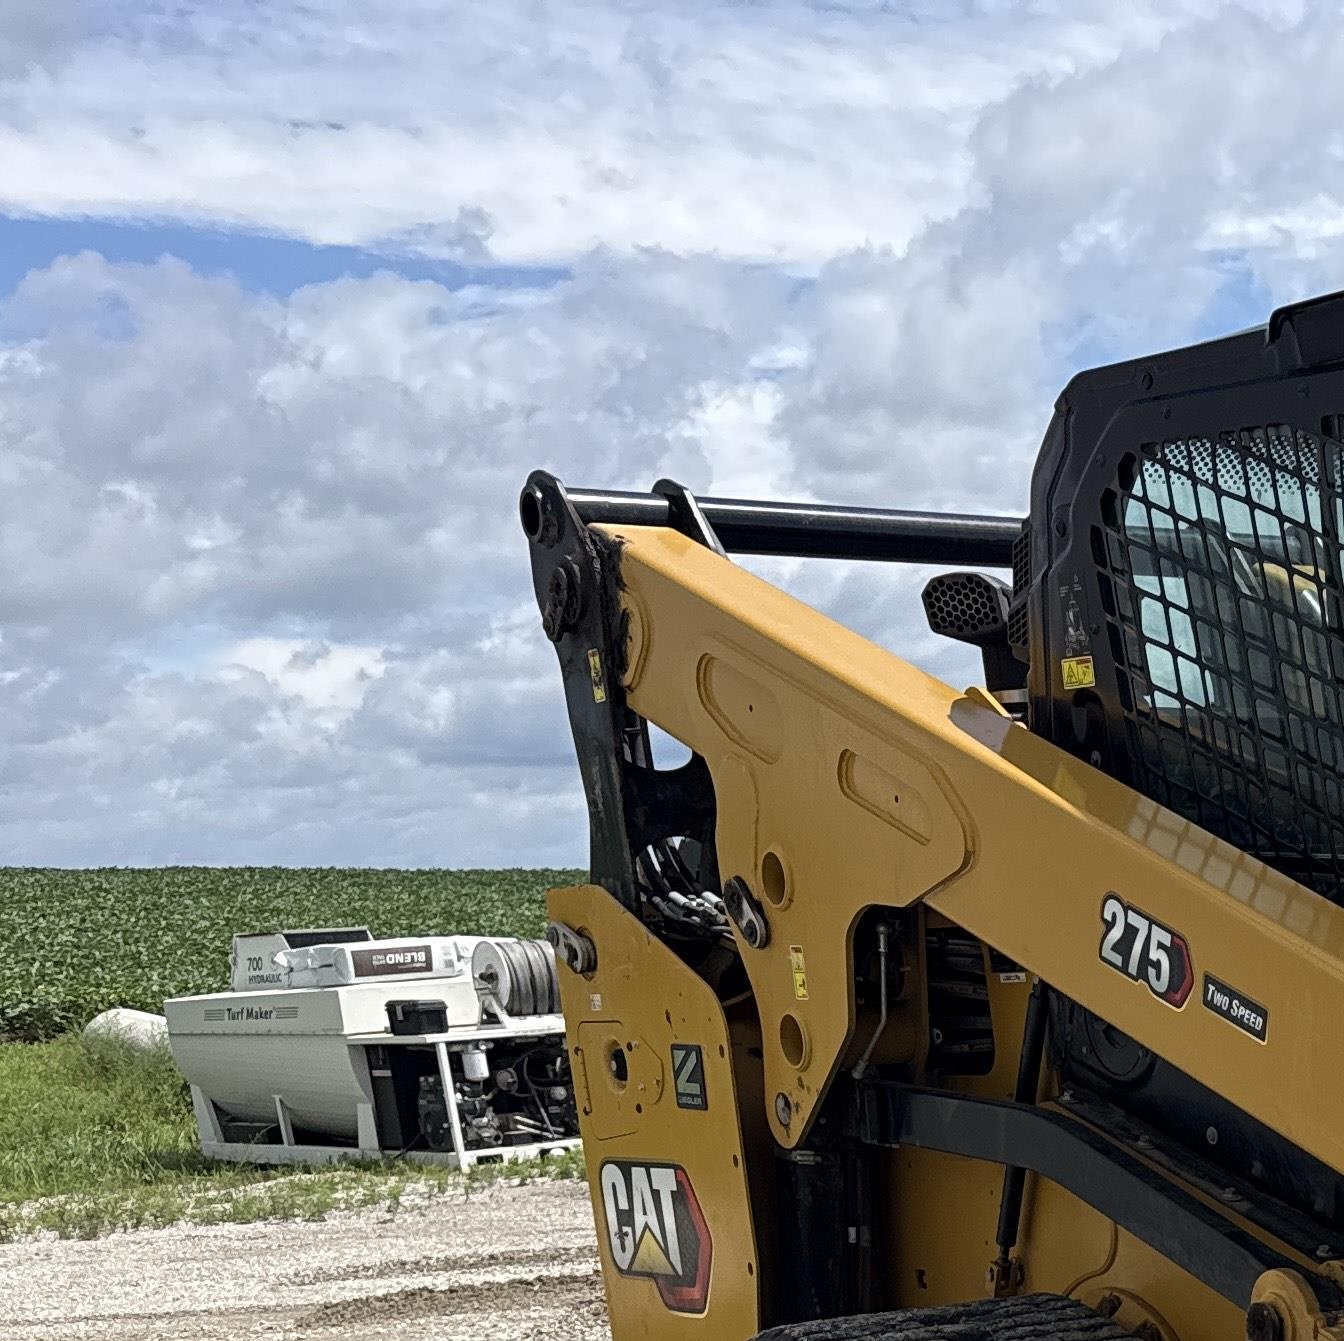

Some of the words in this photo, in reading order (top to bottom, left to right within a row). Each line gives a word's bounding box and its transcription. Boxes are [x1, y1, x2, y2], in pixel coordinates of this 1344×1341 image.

[1101, 898, 1172, 994] 275
[246, 956, 263, 972] 700
[385, 951, 426, 965] BLEND
[226, 1007, 245, 1021] Turf
[246, 1006, 274, 1020] Maker
[601, 1163, 683, 1277] CAT
